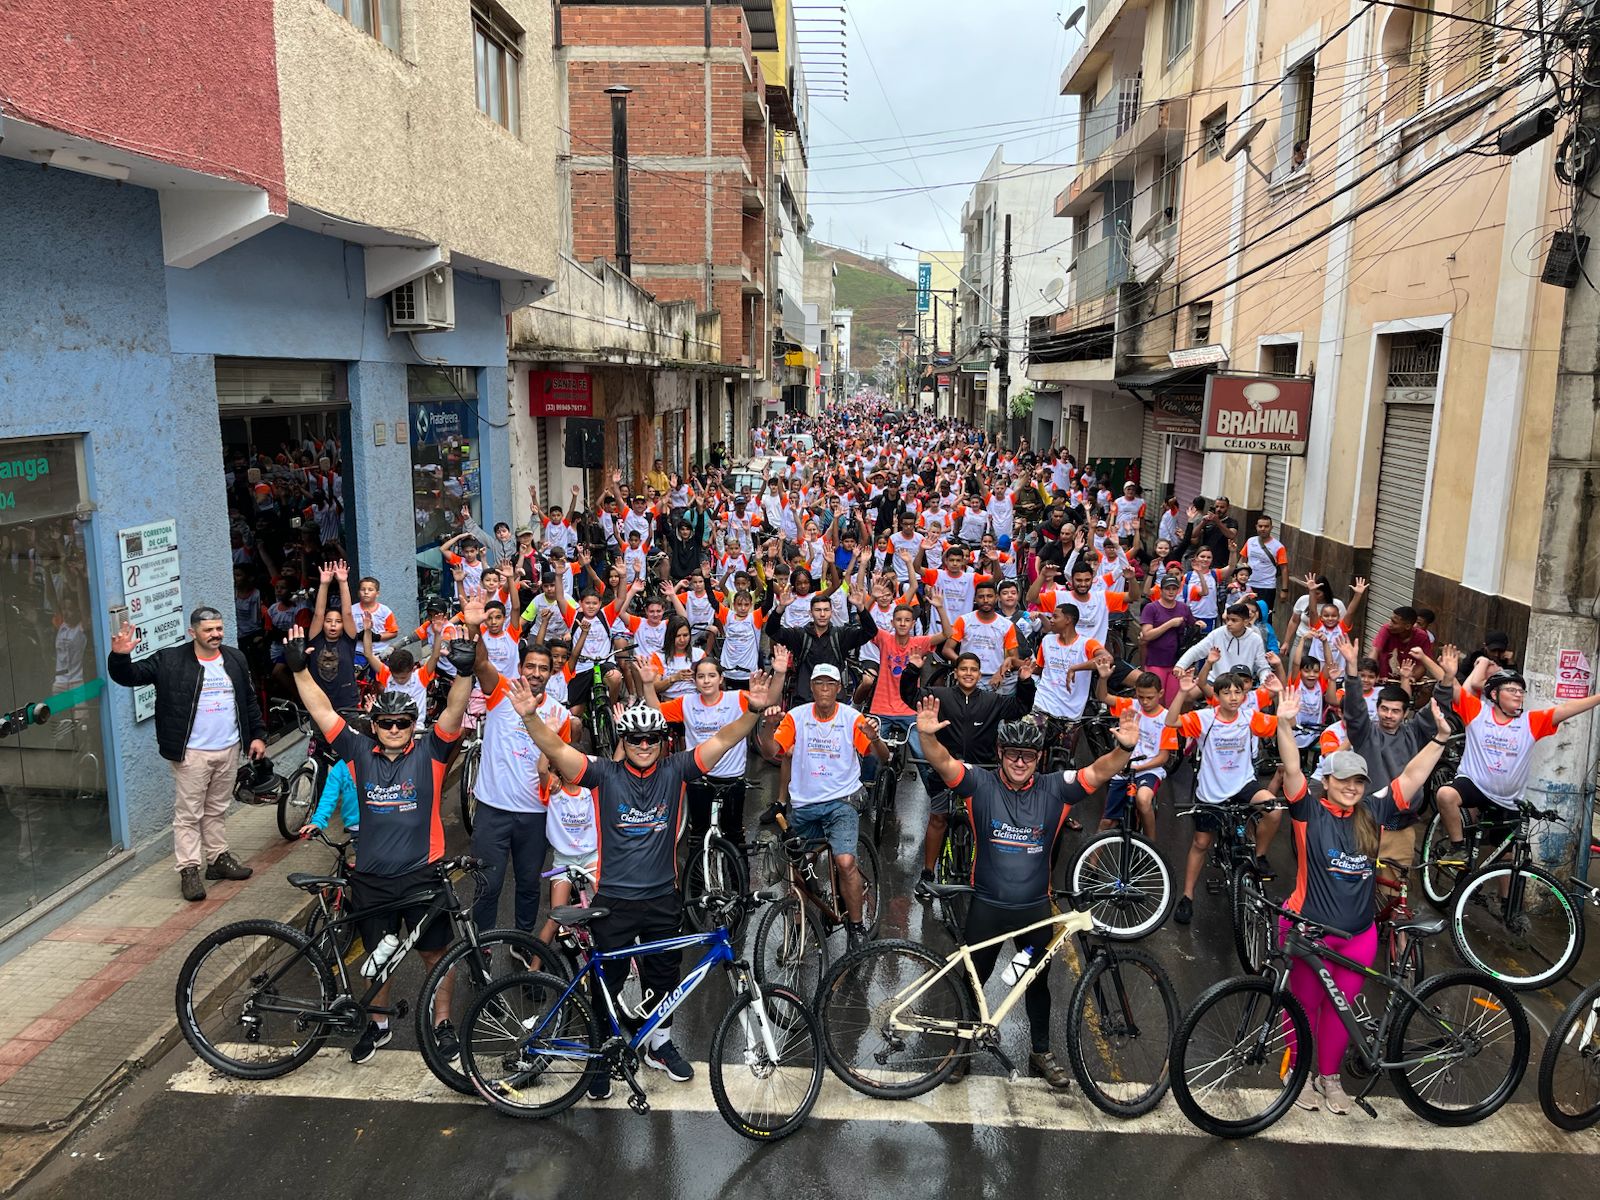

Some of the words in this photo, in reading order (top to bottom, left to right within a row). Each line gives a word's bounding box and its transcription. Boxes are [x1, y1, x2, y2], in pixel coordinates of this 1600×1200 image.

[1216, 409, 1298, 436] BRAHMA
[1270, 441, 1291, 452] BAR
[0, 457, 49, 481] anga
[130, 598, 141, 613] SB
[154, 619, 181, 634] ANDERSON
[993, 829, 1028, 841] Ciclístico
[1001, 822, 1032, 834] Passeio
[1330, 858, 1365, 870] Ciclístico
[1339, 852, 1367, 863] Passeio
[1318, 968, 1349, 1012] CALOI
[657, 985, 684, 1018] CALOI
